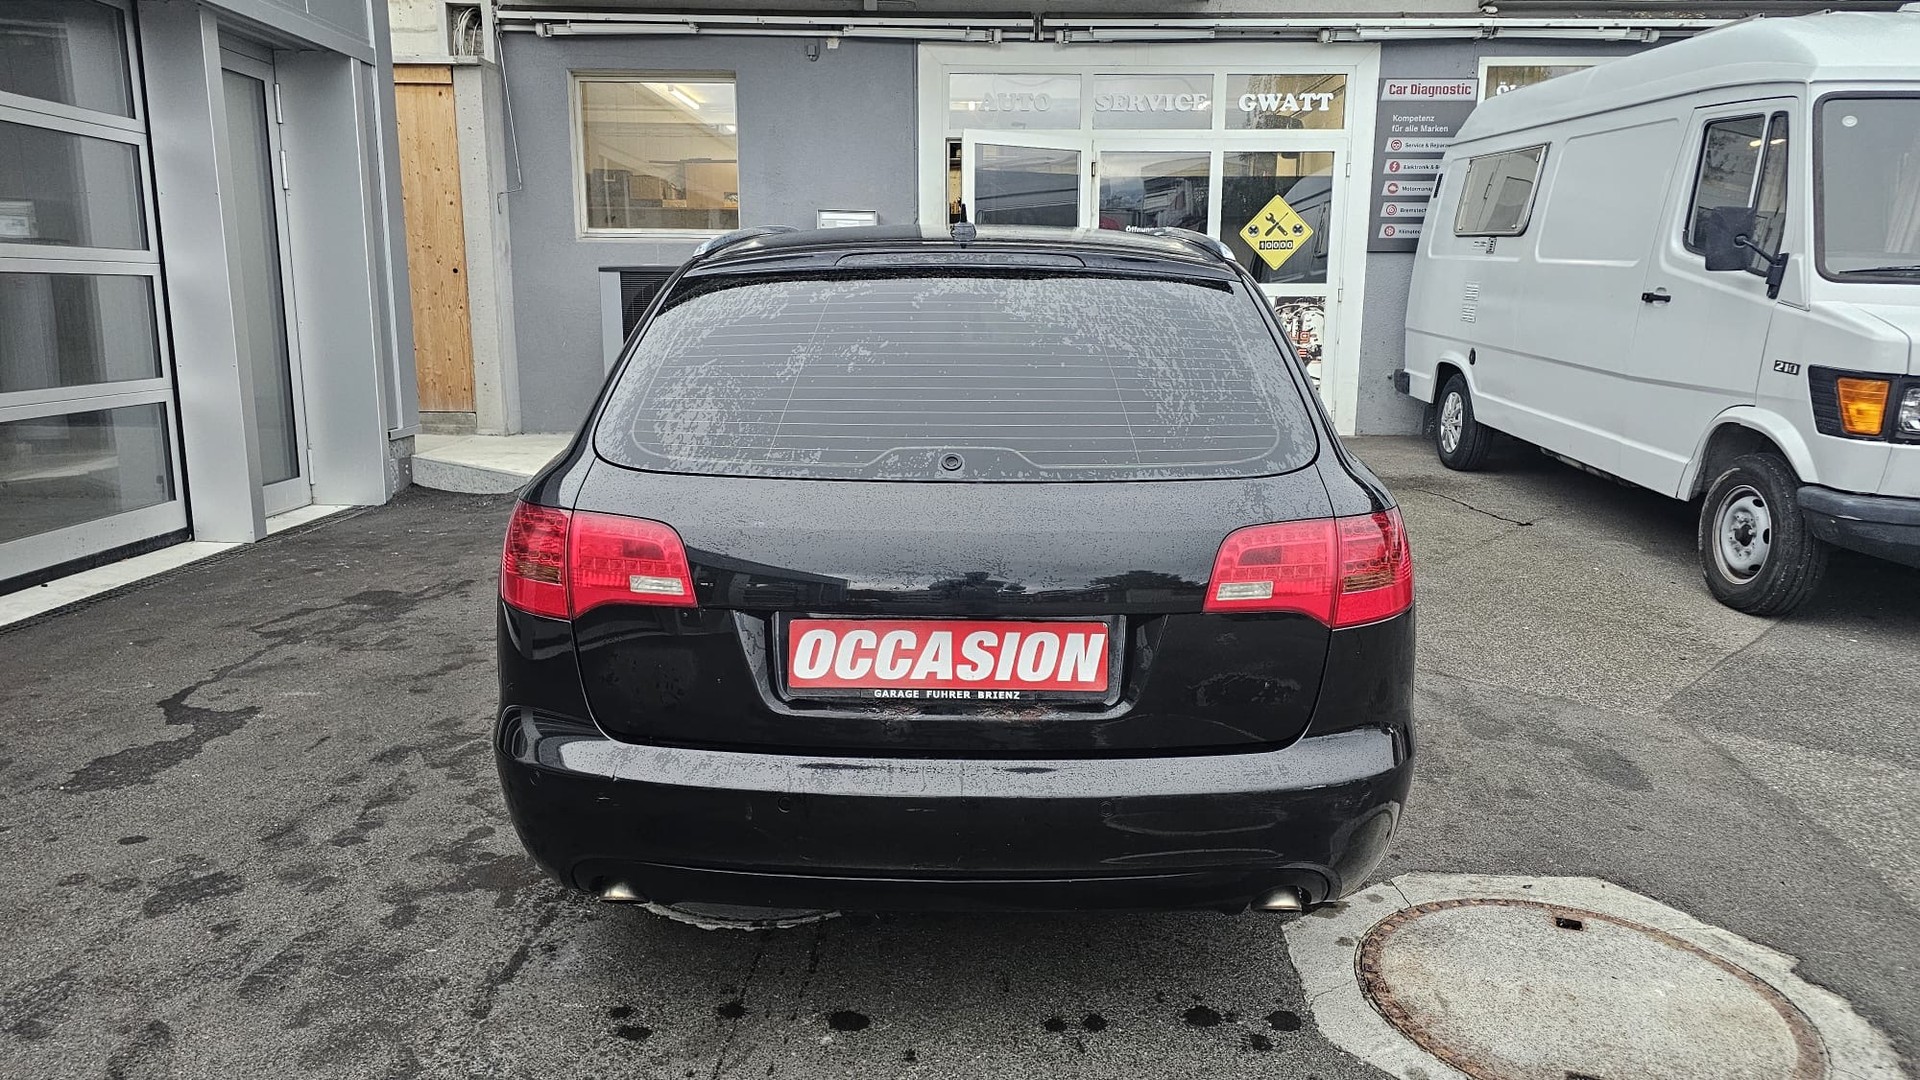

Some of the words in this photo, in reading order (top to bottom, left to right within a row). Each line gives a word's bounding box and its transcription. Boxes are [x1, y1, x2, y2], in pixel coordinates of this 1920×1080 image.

[1389, 83, 1408, 95] Car
[1410, 82, 1472, 98] Diagnostic
[979, 92, 1051, 112] AUTO
[1094, 92, 1208, 112] SERVICE
[1238, 92, 1334, 112] GWATT
[1392, 114, 1435, 123] Kompetenz
[1391, 124, 1403, 132] für
[1405, 124, 1419, 132] alle
[1420, 124, 1449, 132] Marken
[1259, 240, 1294, 250] 10000
[1774, 361, 1799, 375] 210
[792, 628, 1107, 683] OCCASION
[873, 689, 920, 699] GARAGE
[925, 689, 971, 699] FUHRER
[977, 690, 1021, 700] BRIENZ
